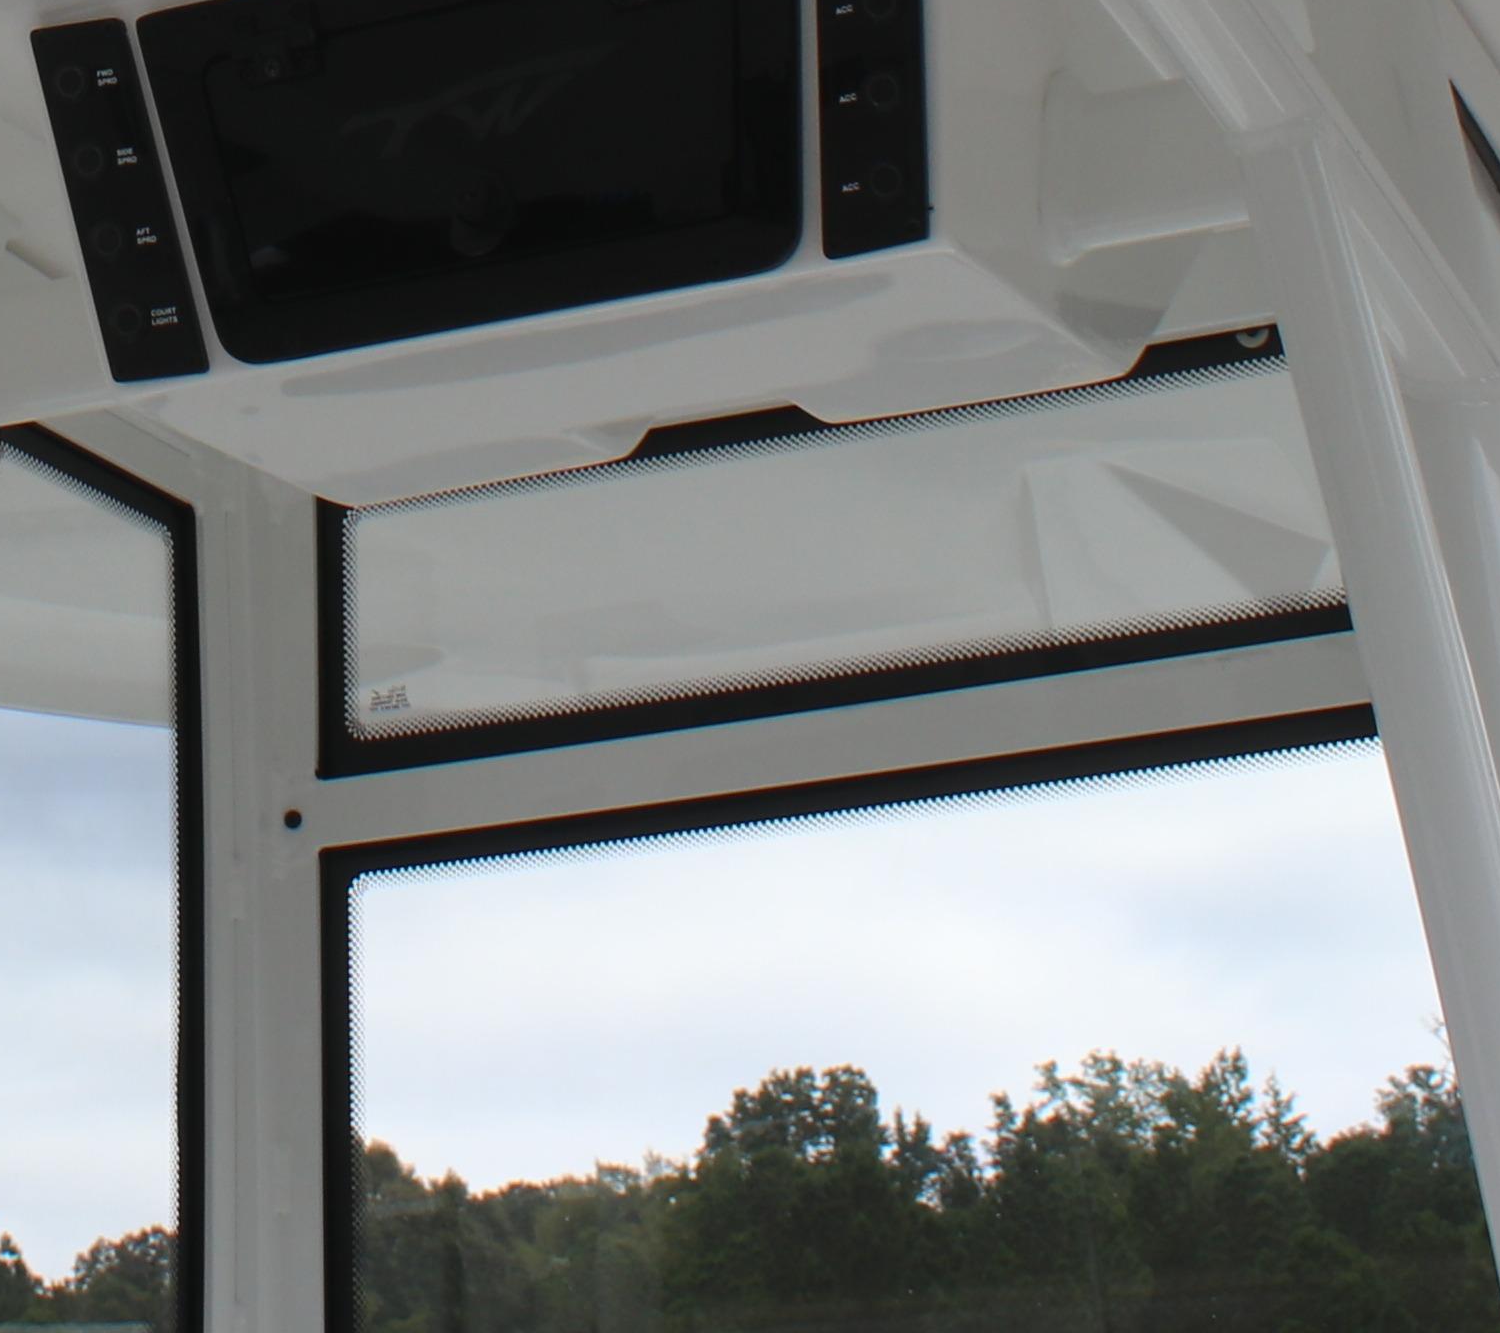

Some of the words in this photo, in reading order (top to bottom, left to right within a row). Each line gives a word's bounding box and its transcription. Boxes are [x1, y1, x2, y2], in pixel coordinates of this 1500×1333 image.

[836, 4, 853, 15] ACC
[96, 69, 113, 77] FWD
[839, 93, 857, 102] ACC
[117, 148, 133, 156] SIDE
[117, 156, 137, 165] SPRD
[842, 182, 859, 192] ACC
[136, 227, 150, 236] AFT
[136, 235, 157, 245] SPRD
[151, 307, 176, 317] COURT
[151, 315, 178, 326] LIGHTS
